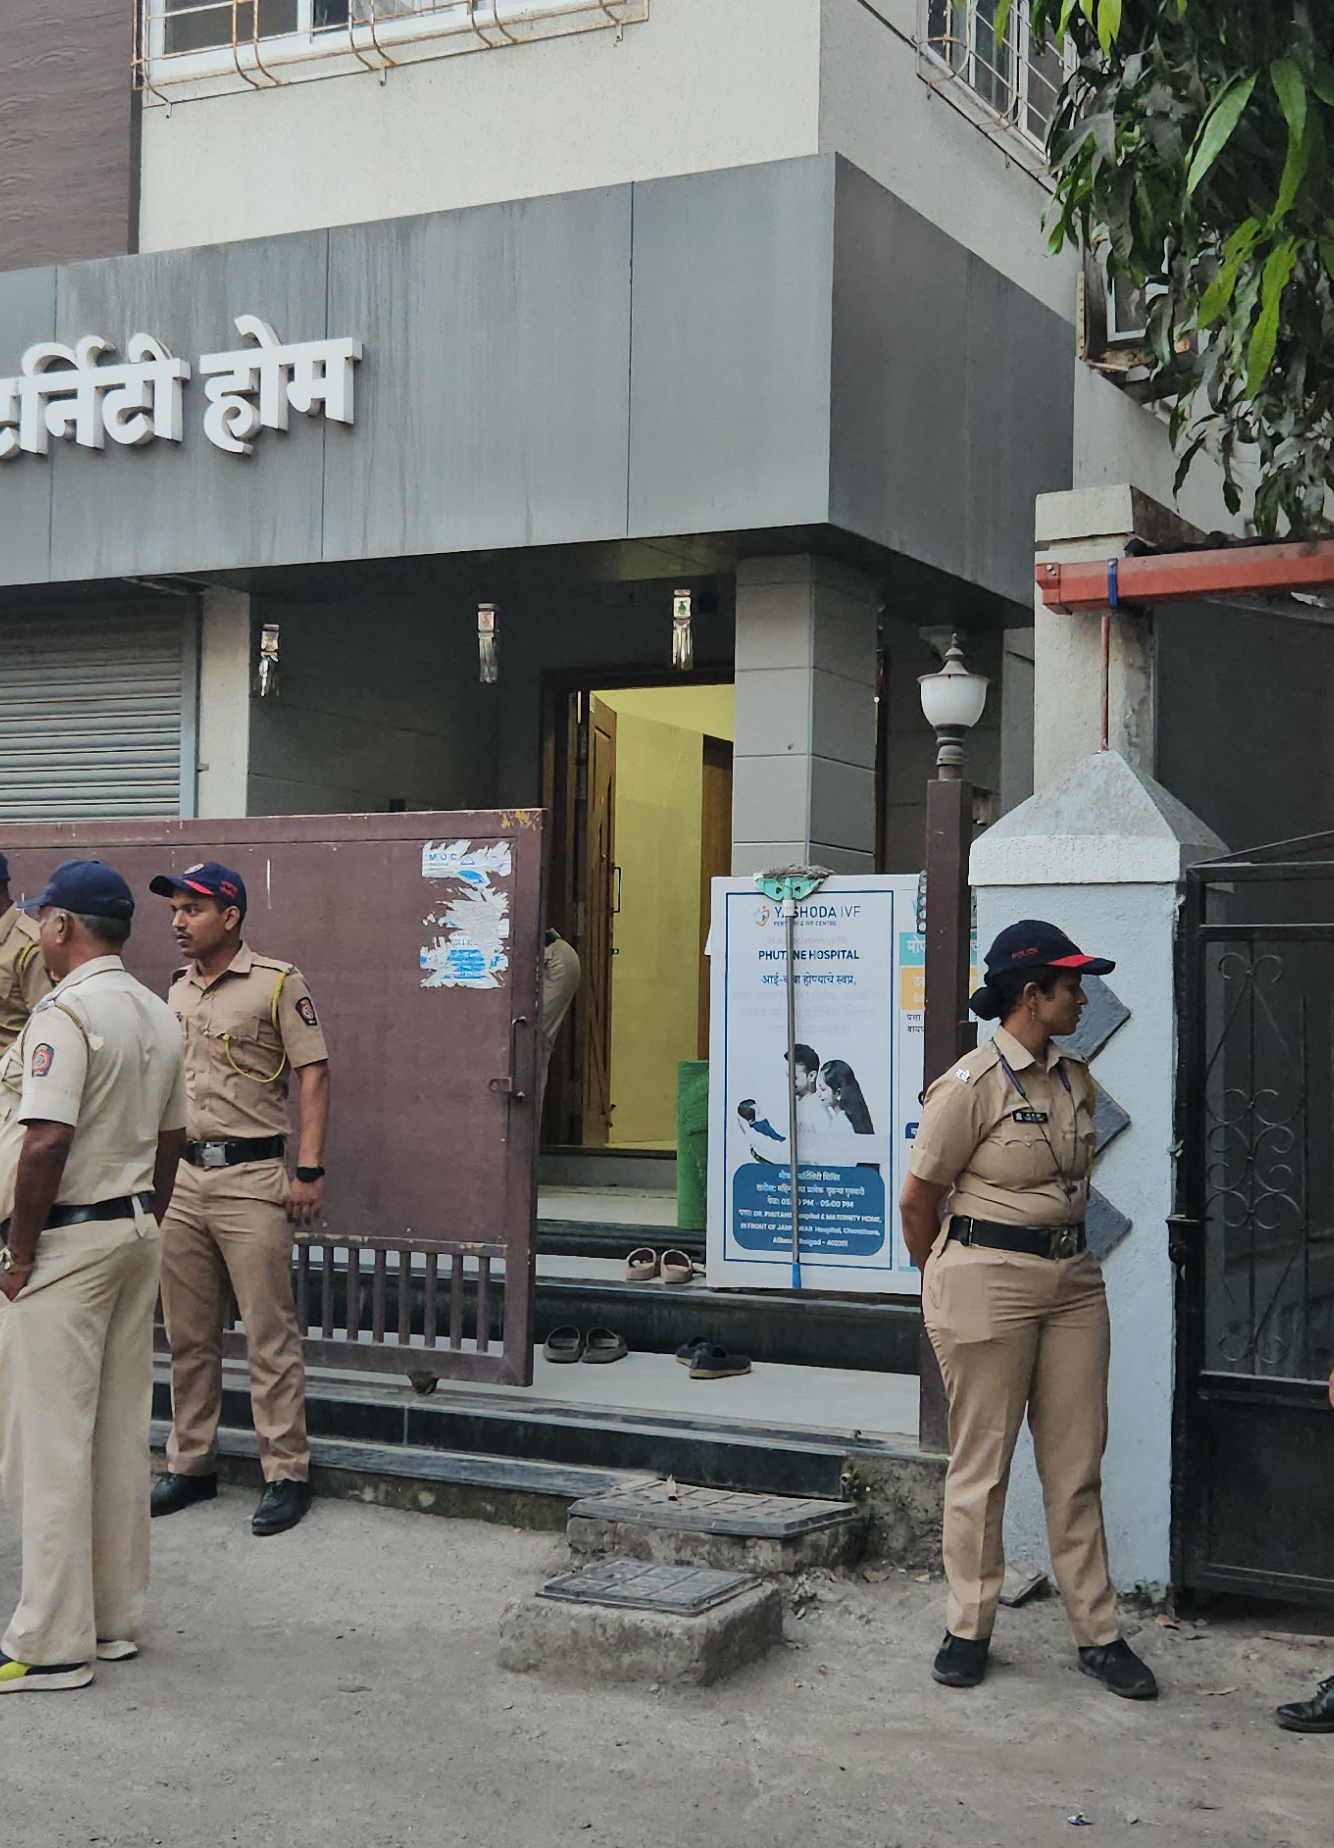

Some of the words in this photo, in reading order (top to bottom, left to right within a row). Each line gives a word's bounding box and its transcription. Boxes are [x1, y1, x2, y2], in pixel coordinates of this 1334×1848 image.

[200, 314, 363, 455] होम
[841, 905, 861, 918] IVF
[758, 950, 807, 960] PHUTNE
[809, 949, 860, 960] HOSPITAL
[803, 971, 834, 987] होण्याचे
